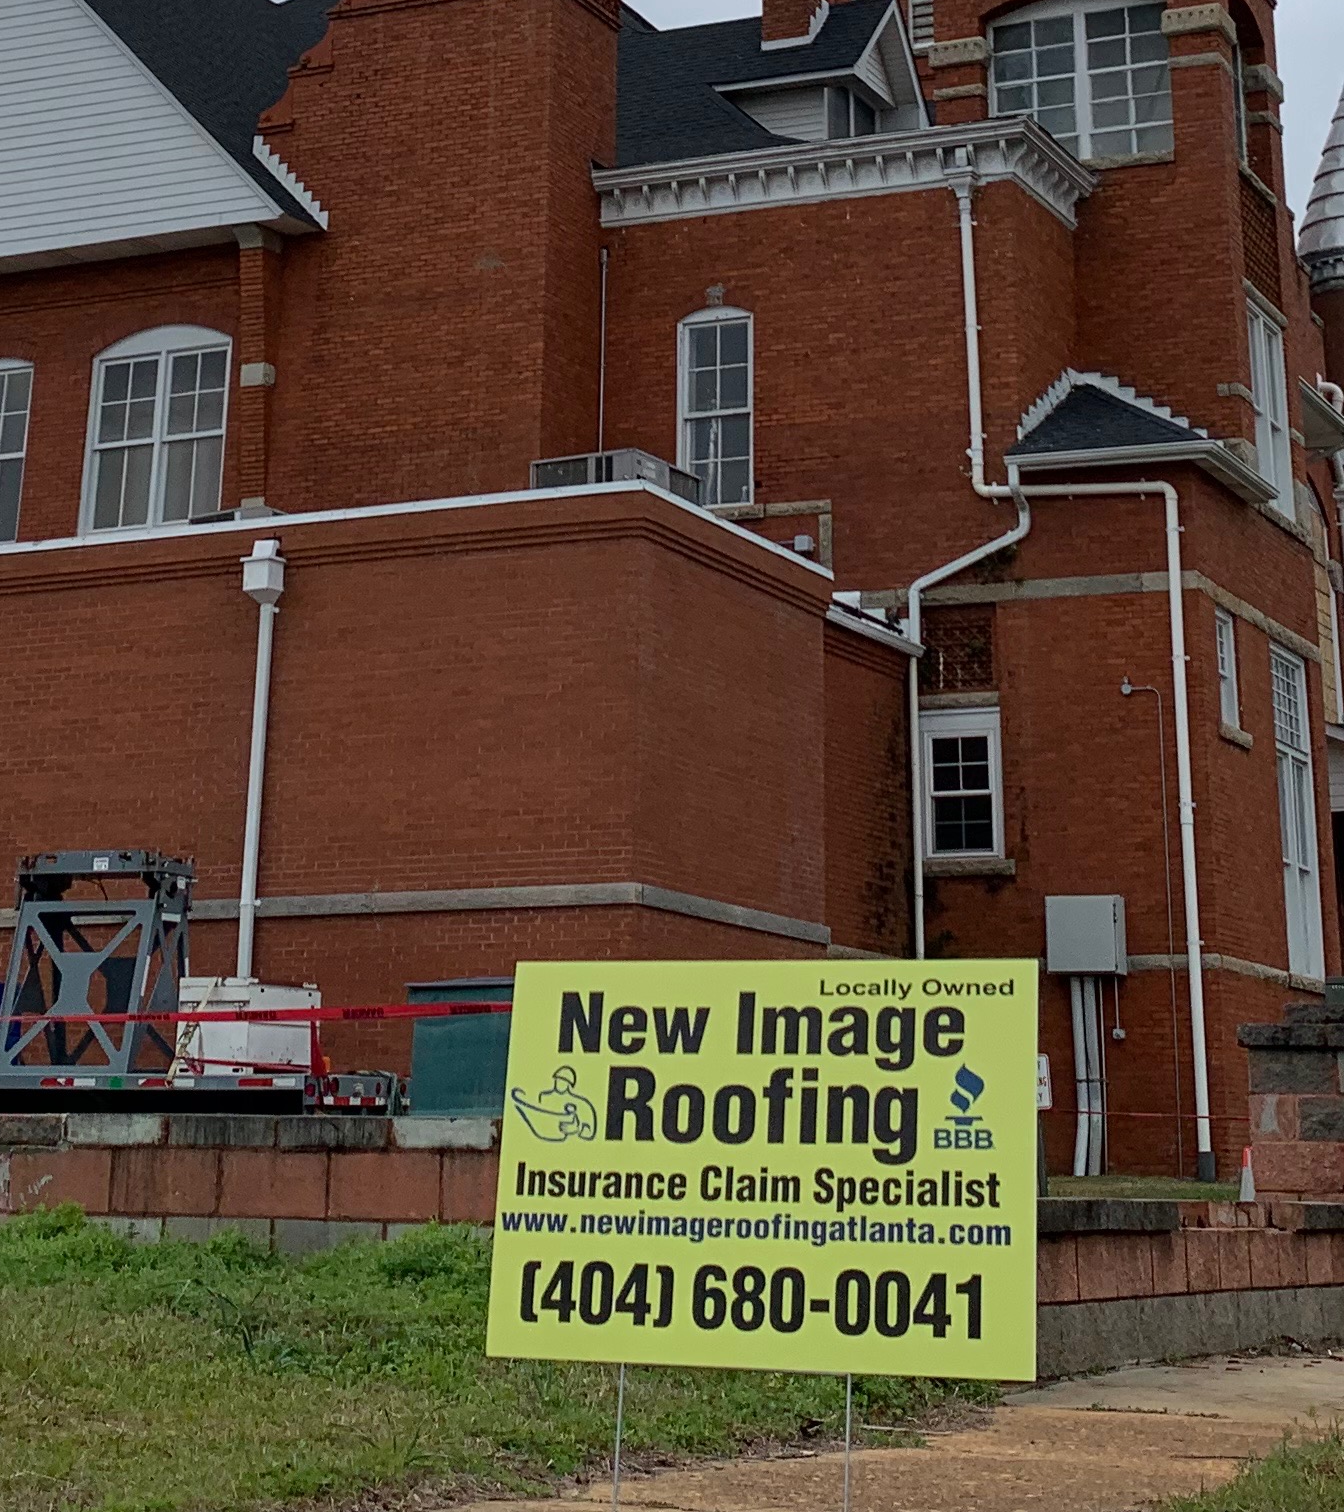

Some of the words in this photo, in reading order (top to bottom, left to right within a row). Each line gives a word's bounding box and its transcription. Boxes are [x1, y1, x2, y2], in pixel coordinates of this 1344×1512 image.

[819, 979, 913, 1000] Locally
[921, 978, 1015, 996] Owned
[557, 991, 710, 1055] New
[736, 991, 965, 1071] Image
[605, 1066, 918, 1165] Roofing
[934, 1129, 993, 1149] BBB
[515, 1162, 687, 1201] Insurance
[700, 1166, 801, 1204] Claim
[813, 1169, 1001, 1213] Specialist
[501, 1209, 1012, 1247] www.newimageroofingatlanta.com
[519, 1260, 674, 1328] (404)
[692, 1264, 983, 1340] 680-0041
